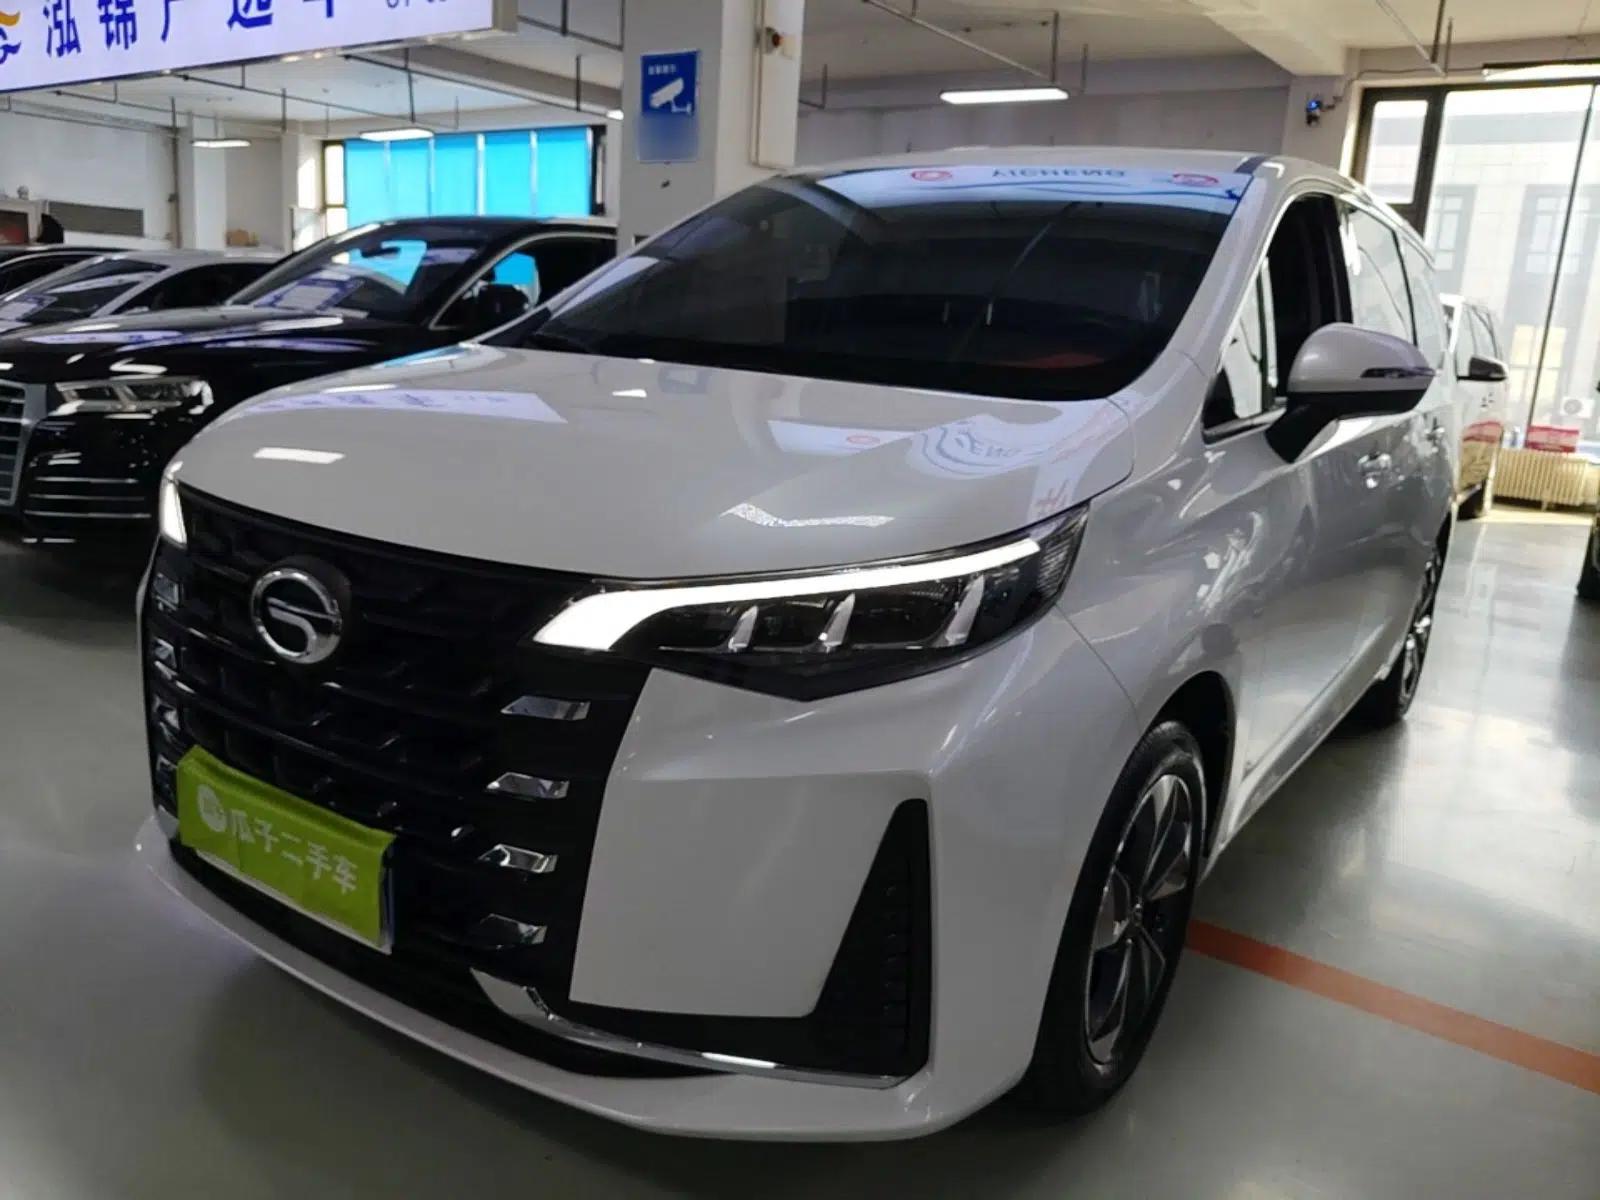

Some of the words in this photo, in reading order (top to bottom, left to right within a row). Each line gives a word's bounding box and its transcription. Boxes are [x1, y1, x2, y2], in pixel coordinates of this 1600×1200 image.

[229, 809, 358, 895] 瓜子二手车
